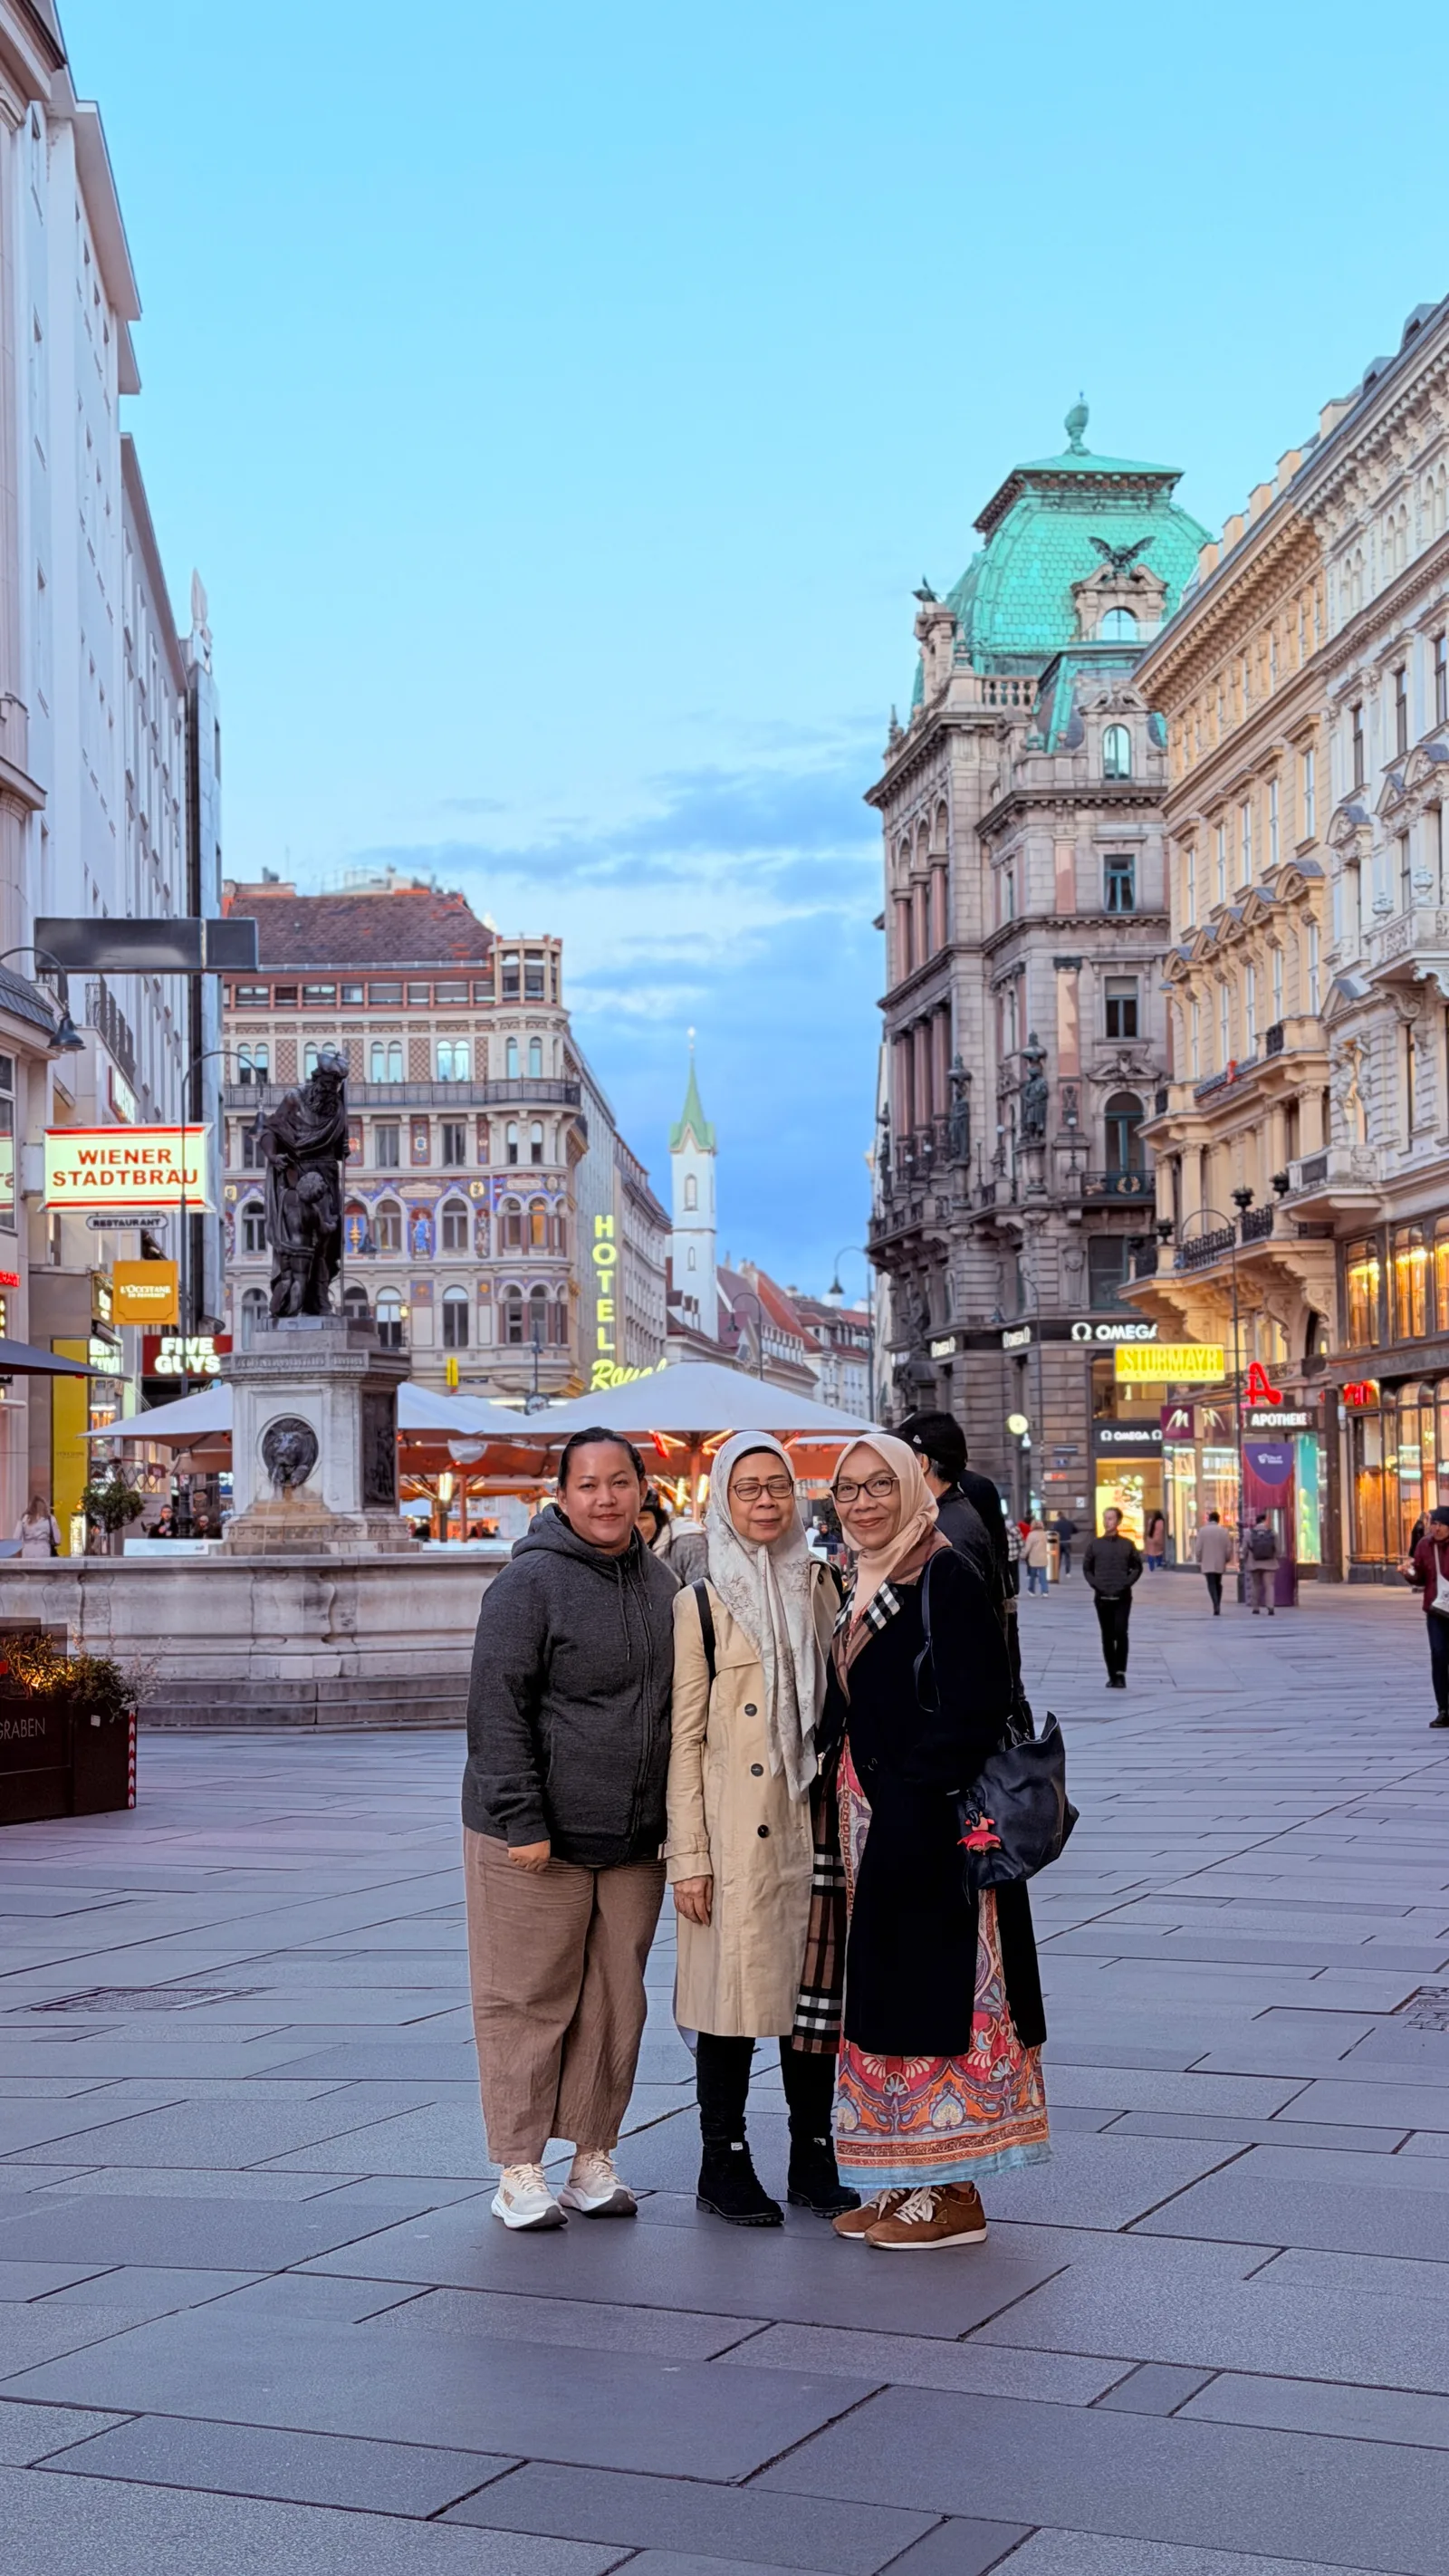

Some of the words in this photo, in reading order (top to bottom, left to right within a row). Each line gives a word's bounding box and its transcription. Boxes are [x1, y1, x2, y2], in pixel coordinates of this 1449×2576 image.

[78, 1148, 172, 1165] WIENER
[52, 1168, 198, 1187] STADTBRÄU
[92, 1218, 160, 1228] RESTAURANT
[592, 1214, 617, 1350] HOTEL
[1095, 1323, 1158, 1341] OMEGA
[160, 1336, 215, 1356] FIVE
[154, 1354, 221, 1374] GUYS
[1251, 1411, 1307, 1427] APOTHEKE
[1113, 1430, 1150, 1442] OMEGA
